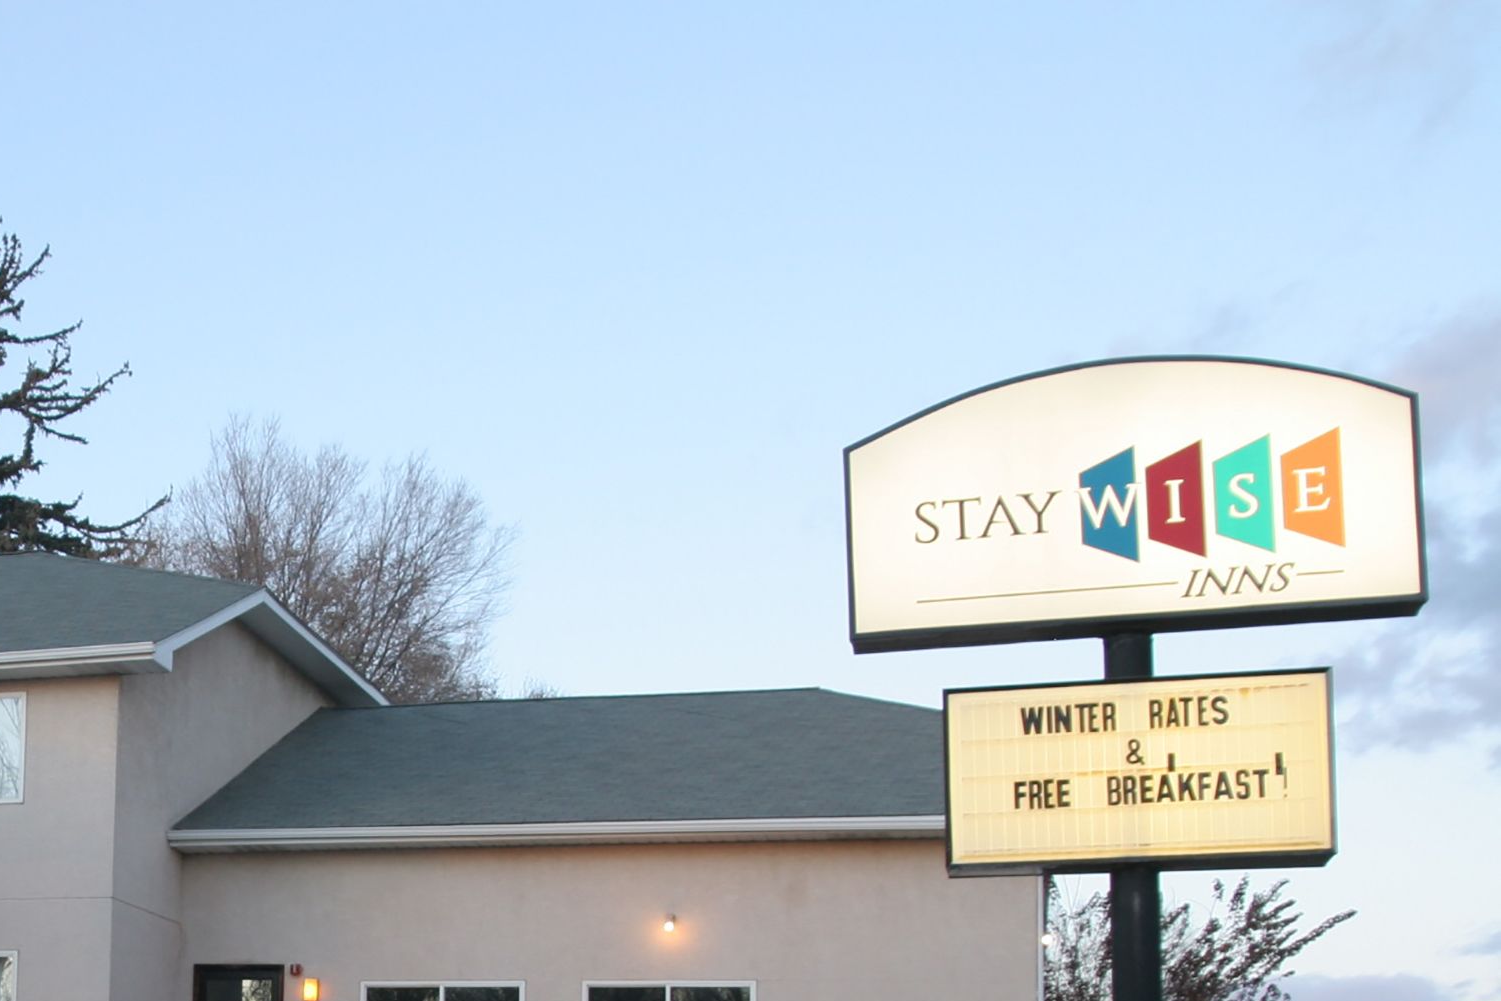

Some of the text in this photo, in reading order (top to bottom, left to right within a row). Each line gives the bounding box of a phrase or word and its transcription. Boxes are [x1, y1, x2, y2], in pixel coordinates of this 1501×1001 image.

[915, 466, 1331, 544] STAY WISE
[1181, 562, 1295, 598] INNS
[1021, 696, 1229, 735] WINTER RATES
[1126, 739, 1145, 765] &
[1014, 779, 1070, 809] FREE
